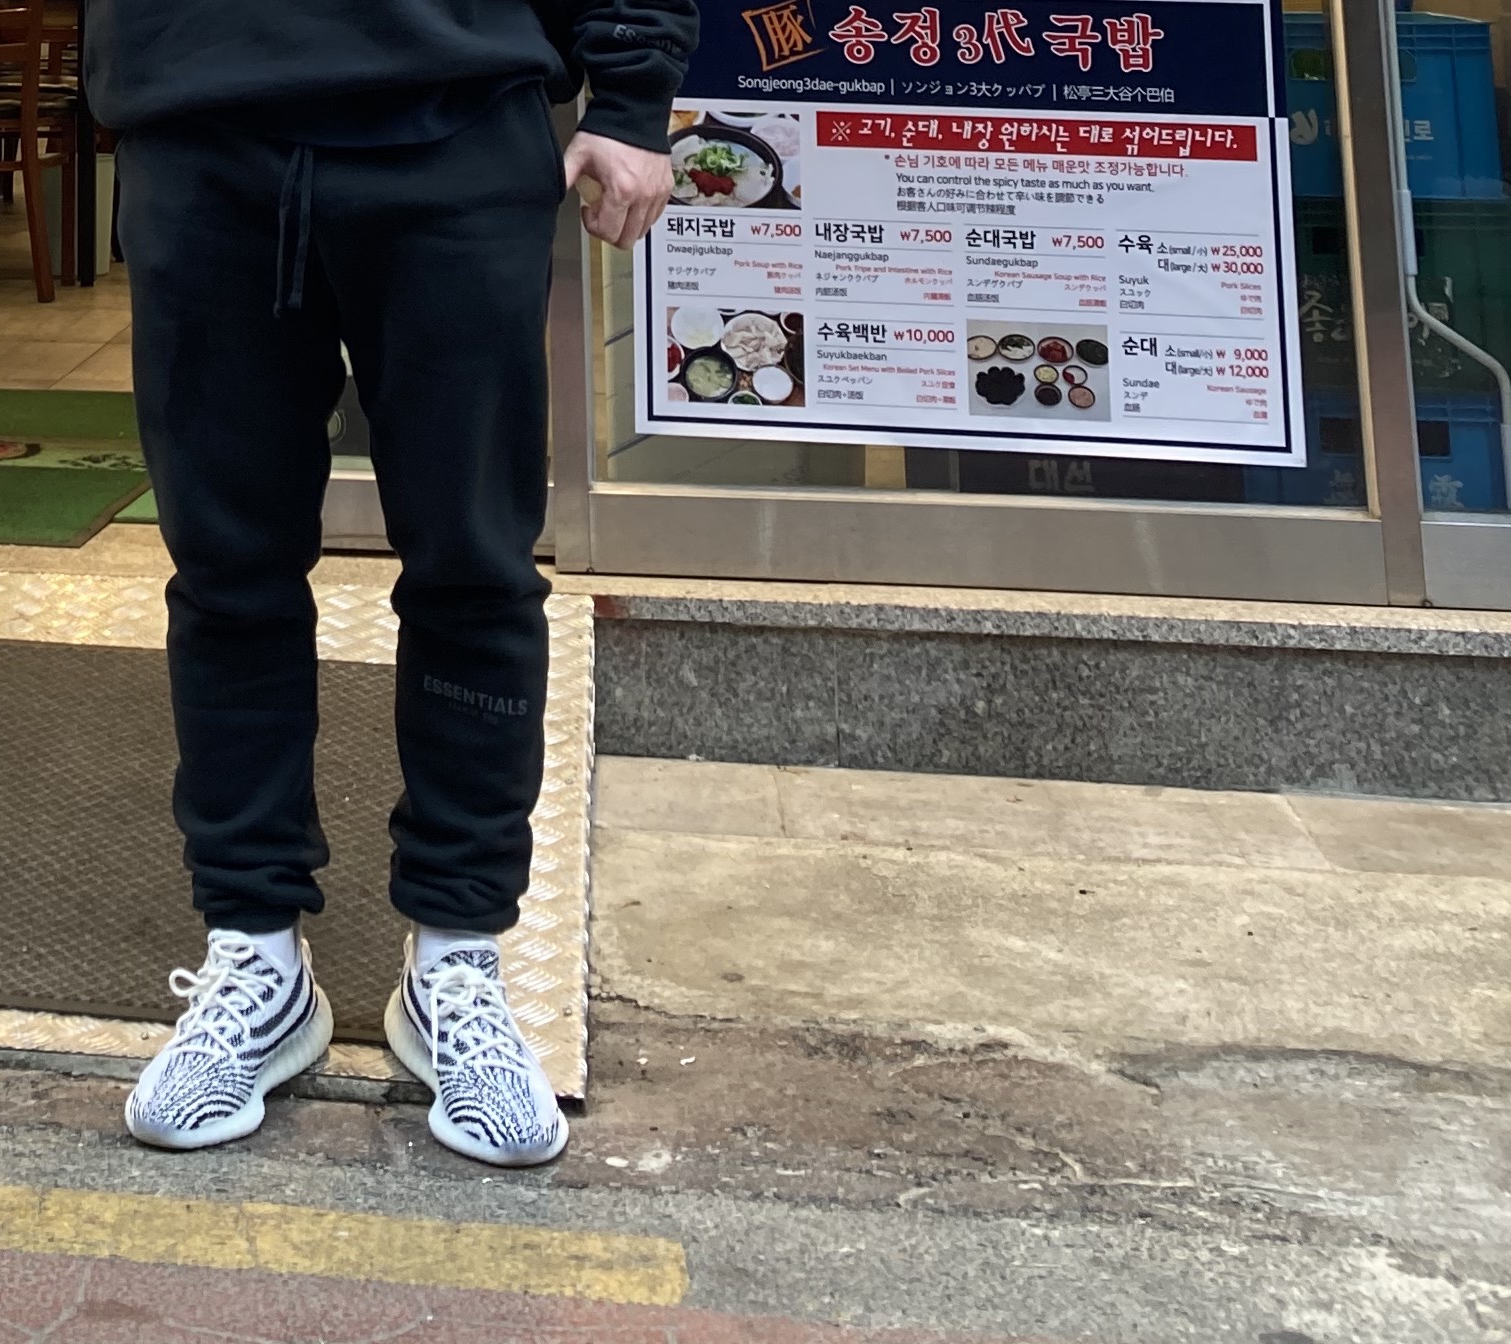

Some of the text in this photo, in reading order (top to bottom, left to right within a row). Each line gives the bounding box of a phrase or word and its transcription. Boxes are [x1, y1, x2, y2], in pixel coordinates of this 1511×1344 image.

[828, 5, 1165, 72] 송정 3代 국밥
[738, 75, 885, 95] Songjeong3dae-gukbap
[951, 120, 993, 150] 내장
[999, 122, 1071, 153] 원하시는
[1079, 124, 1114, 143] 대로
[894, 154, 919, 169] 손님
[923, 155, 961, 170] 기호에
[994, 158, 1019, 172] 모든
[1023, 159, 1048, 173] 메뉴
[1052, 160, 1089, 175] 매운맛
[896, 173, 915, 184] You
[916, 175, 935, 185] can
[936, 175, 972, 187] control
[974, 176, 991, 187] the
[992, 177, 1018, 189] spicy
[1020, 178, 1046, 189] taste
[1049, 180, 1060, 189] as
[1062, 179, 1090, 191] much
[1092, 182, 1104, 191] as
[1106, 182, 1125, 194] you
[667, 217, 735, 238] 돼지국밥
[815, 223, 884, 244] 내장국밥
[965, 228, 1037, 250] 순대국밥
[1118, 234, 1154, 255] 수육
[667, 244, 733, 257] Dwaejigukbap
[814, 250, 889, 262] Naejanggukbap
[965, 256, 1038, 269] Sundaegukbap
[1118, 275, 1149, 286] Suyuk
[817, 322, 888, 343] 수육백반
[816, 349, 888, 361] Suyukbaekban
[1122, 336, 1158, 357] 순대
[1122, 378, 1160, 390] Sundae
